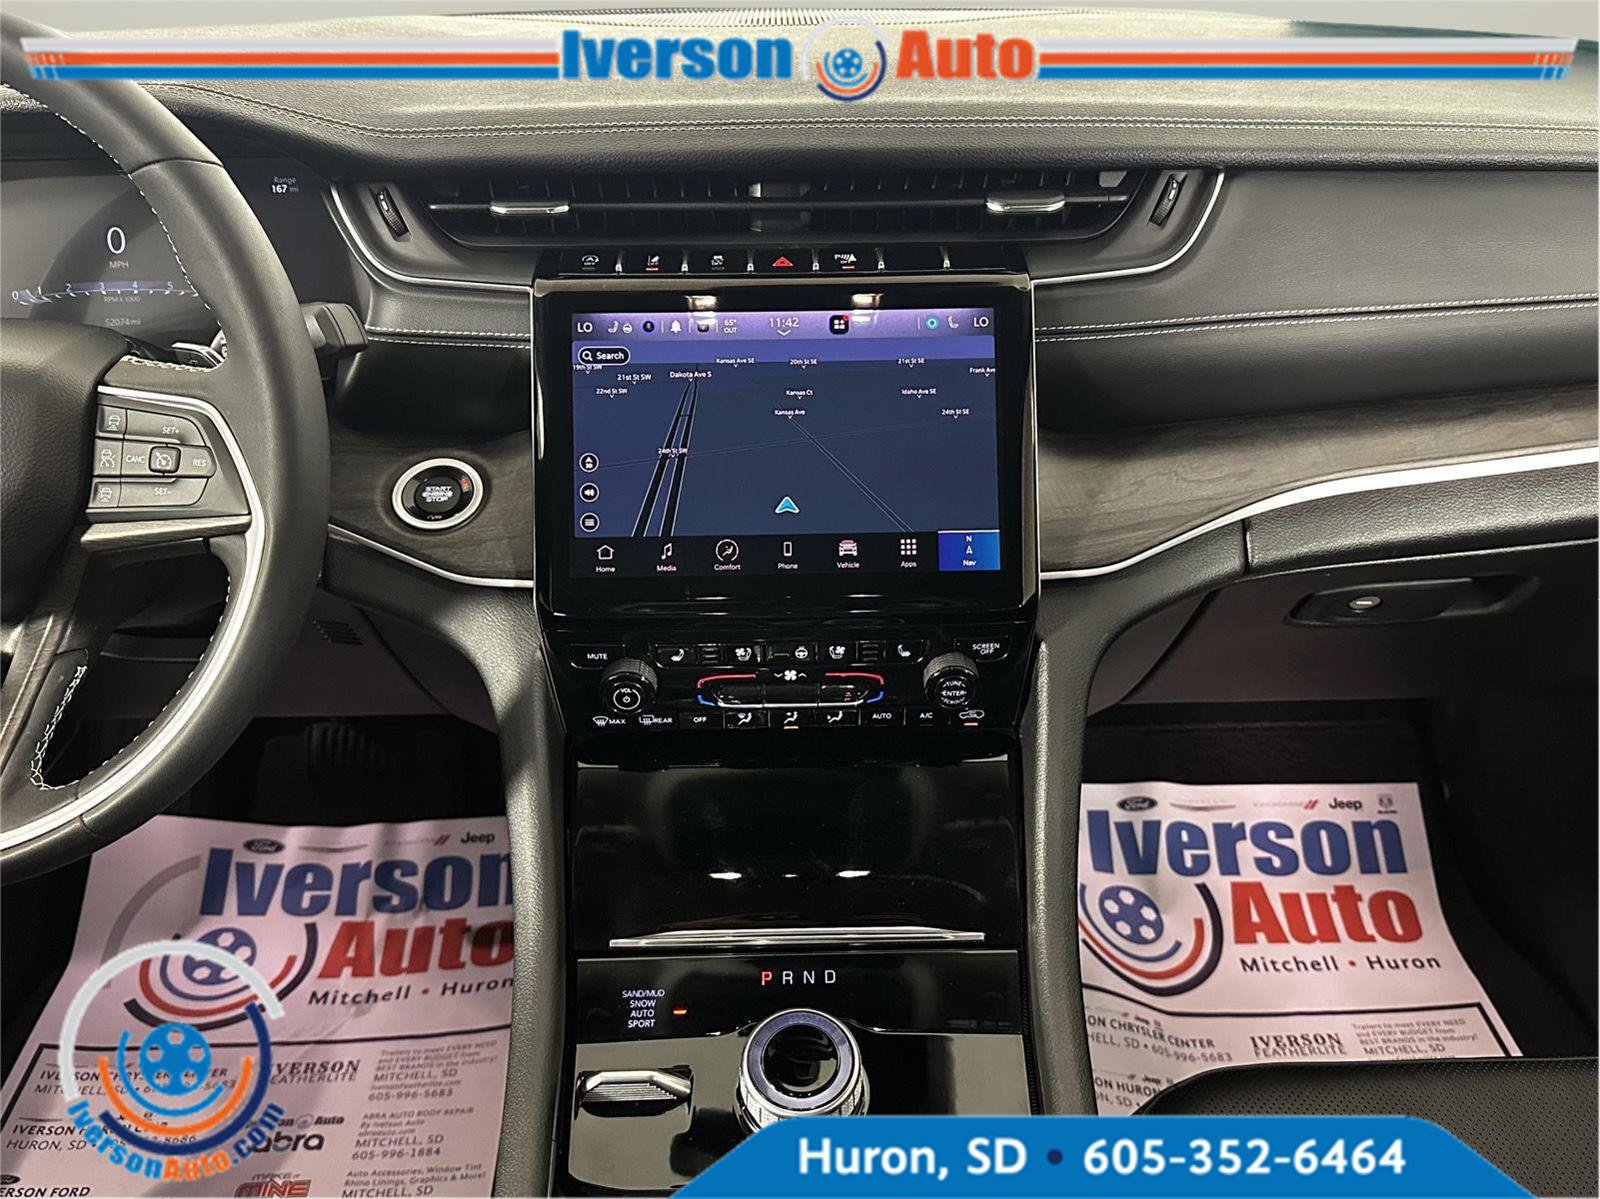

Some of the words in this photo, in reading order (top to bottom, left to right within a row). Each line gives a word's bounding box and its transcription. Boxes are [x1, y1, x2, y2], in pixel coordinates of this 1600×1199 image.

[274, 176, 297, 185] Range
[271, 184, 287, 194] 167
[106, 226, 126, 254] 0
[109, 261, 129, 269] MPH
[132, 281, 138, 289] 4
[167, 281, 174, 290] 5
[577, 322, 593, 332] LO
[769, 317, 800, 328] 11:42
[973, 316, 989, 327] LO
[596, 351, 624, 361] Search
[126, 455, 145, 464] CANC
[900, 561, 917, 569] Apps
[1329, 797, 1363, 811] Jeep
[461, 832, 495, 844] Jeep
[1086, 810, 1408, 876] Iverson
[200, 848, 513, 916] Iverson
[1230, 881, 1423, 945] Auto
[318, 917, 513, 979] Auto
[1239, 954, 1338, 973] Mitchell
[1366, 954, 1441, 970] Huron
[761, 971, 773, 986] P
[783, 971, 793, 984] R
[803, 970, 815, 984] N
[825, 969, 836, 983] D
[309, 986, 410, 1006] Mitchell
[440, 977, 513, 997] Huron
[622, 989, 665, 998] SAND/MUD
[630, 999, 656, 1008] SNOW
[630, 1009, 655, 1018] AUTO
[627, 1019, 656, 1028] SPORT
[1110, 1018, 1165, 1042] CHRYSLER
[1167, 1034, 1215, 1048] CENTER
[1124, 1037, 1140, 1049] SD
[1250, 1033, 1343, 1048] IVERSON
[1363, 1044, 1428, 1055] MITCHELL,
[1429, 1043, 1446, 1053] SD
[274, 1060, 362, 1075] VERSON
[270, 1072, 356, 1085] EATHERLITE
[374, 1070, 438, 1081] MITCHELL,
[441, 1068, 458, 1077] SD
[388, 1110, 415, 1119] AUTO
[416, 1108, 442, 1117] BODY
[443, 1107, 474, 1116] REPAIR
[314, 1116, 345, 1126] Auto
[12, 1124, 75, 1136] IVERSON
[6, 1139, 62, 1151] HURON,
[68, 1139, 87, 1150] SD
[355, 1136, 422, 1148] MITCHELL,
[427, 1133, 444, 1144] SD
[352, 1147, 440, 1160] 605-996-1884
[346, 1170, 369, 1178] Auto
[370, 1167, 425, 1176] Accessories,
[427, 1165, 462, 1173] Window
[344, 1179, 370, 1187] Rhino
[409, 1175, 448, 1184] Graphics
[50, 1186, 90, 1198] FORD
[341, 1186, 412, 1198] MITCHELL,
[415, 1185, 433, 1196] SD
